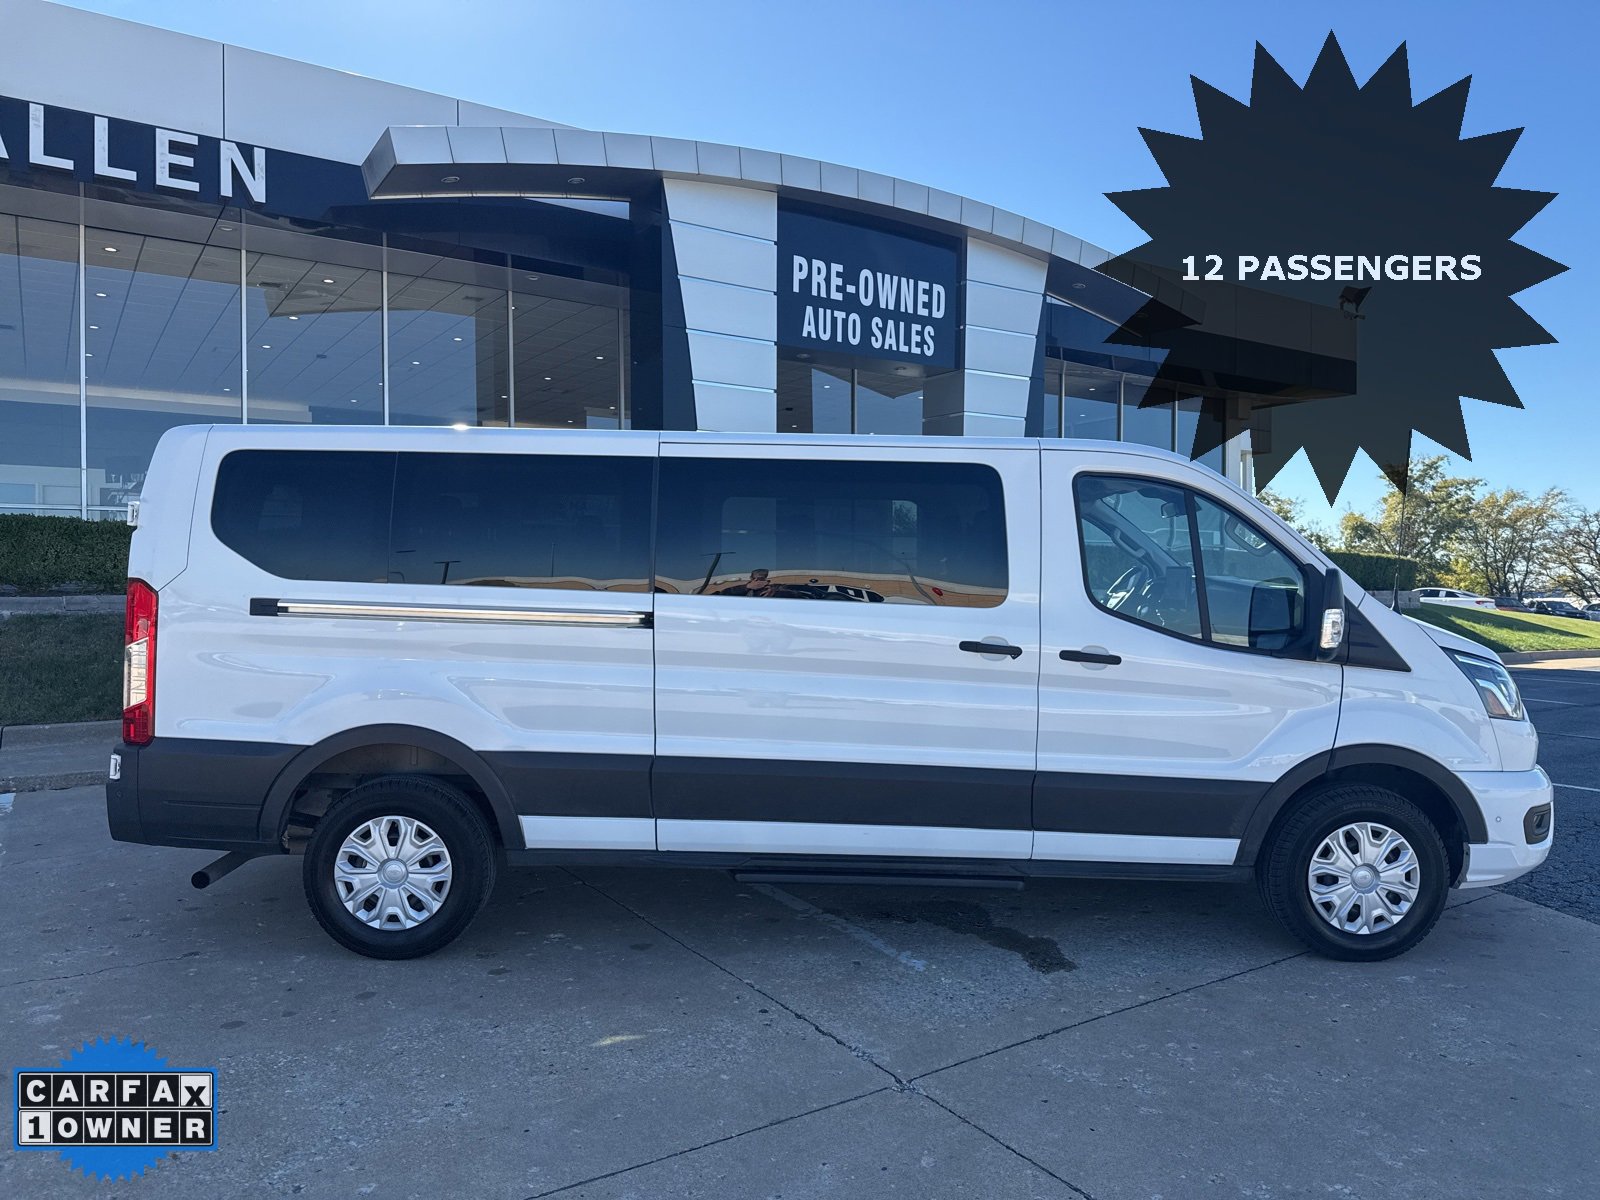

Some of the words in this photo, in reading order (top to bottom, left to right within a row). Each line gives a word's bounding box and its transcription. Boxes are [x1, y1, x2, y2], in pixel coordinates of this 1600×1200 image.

[0, 102, 266, 203] LLEN
[792, 254, 946, 319] PRE-OWNED
[802, 305, 861, 346] AUTO
[870, 316, 935, 357] SALES
